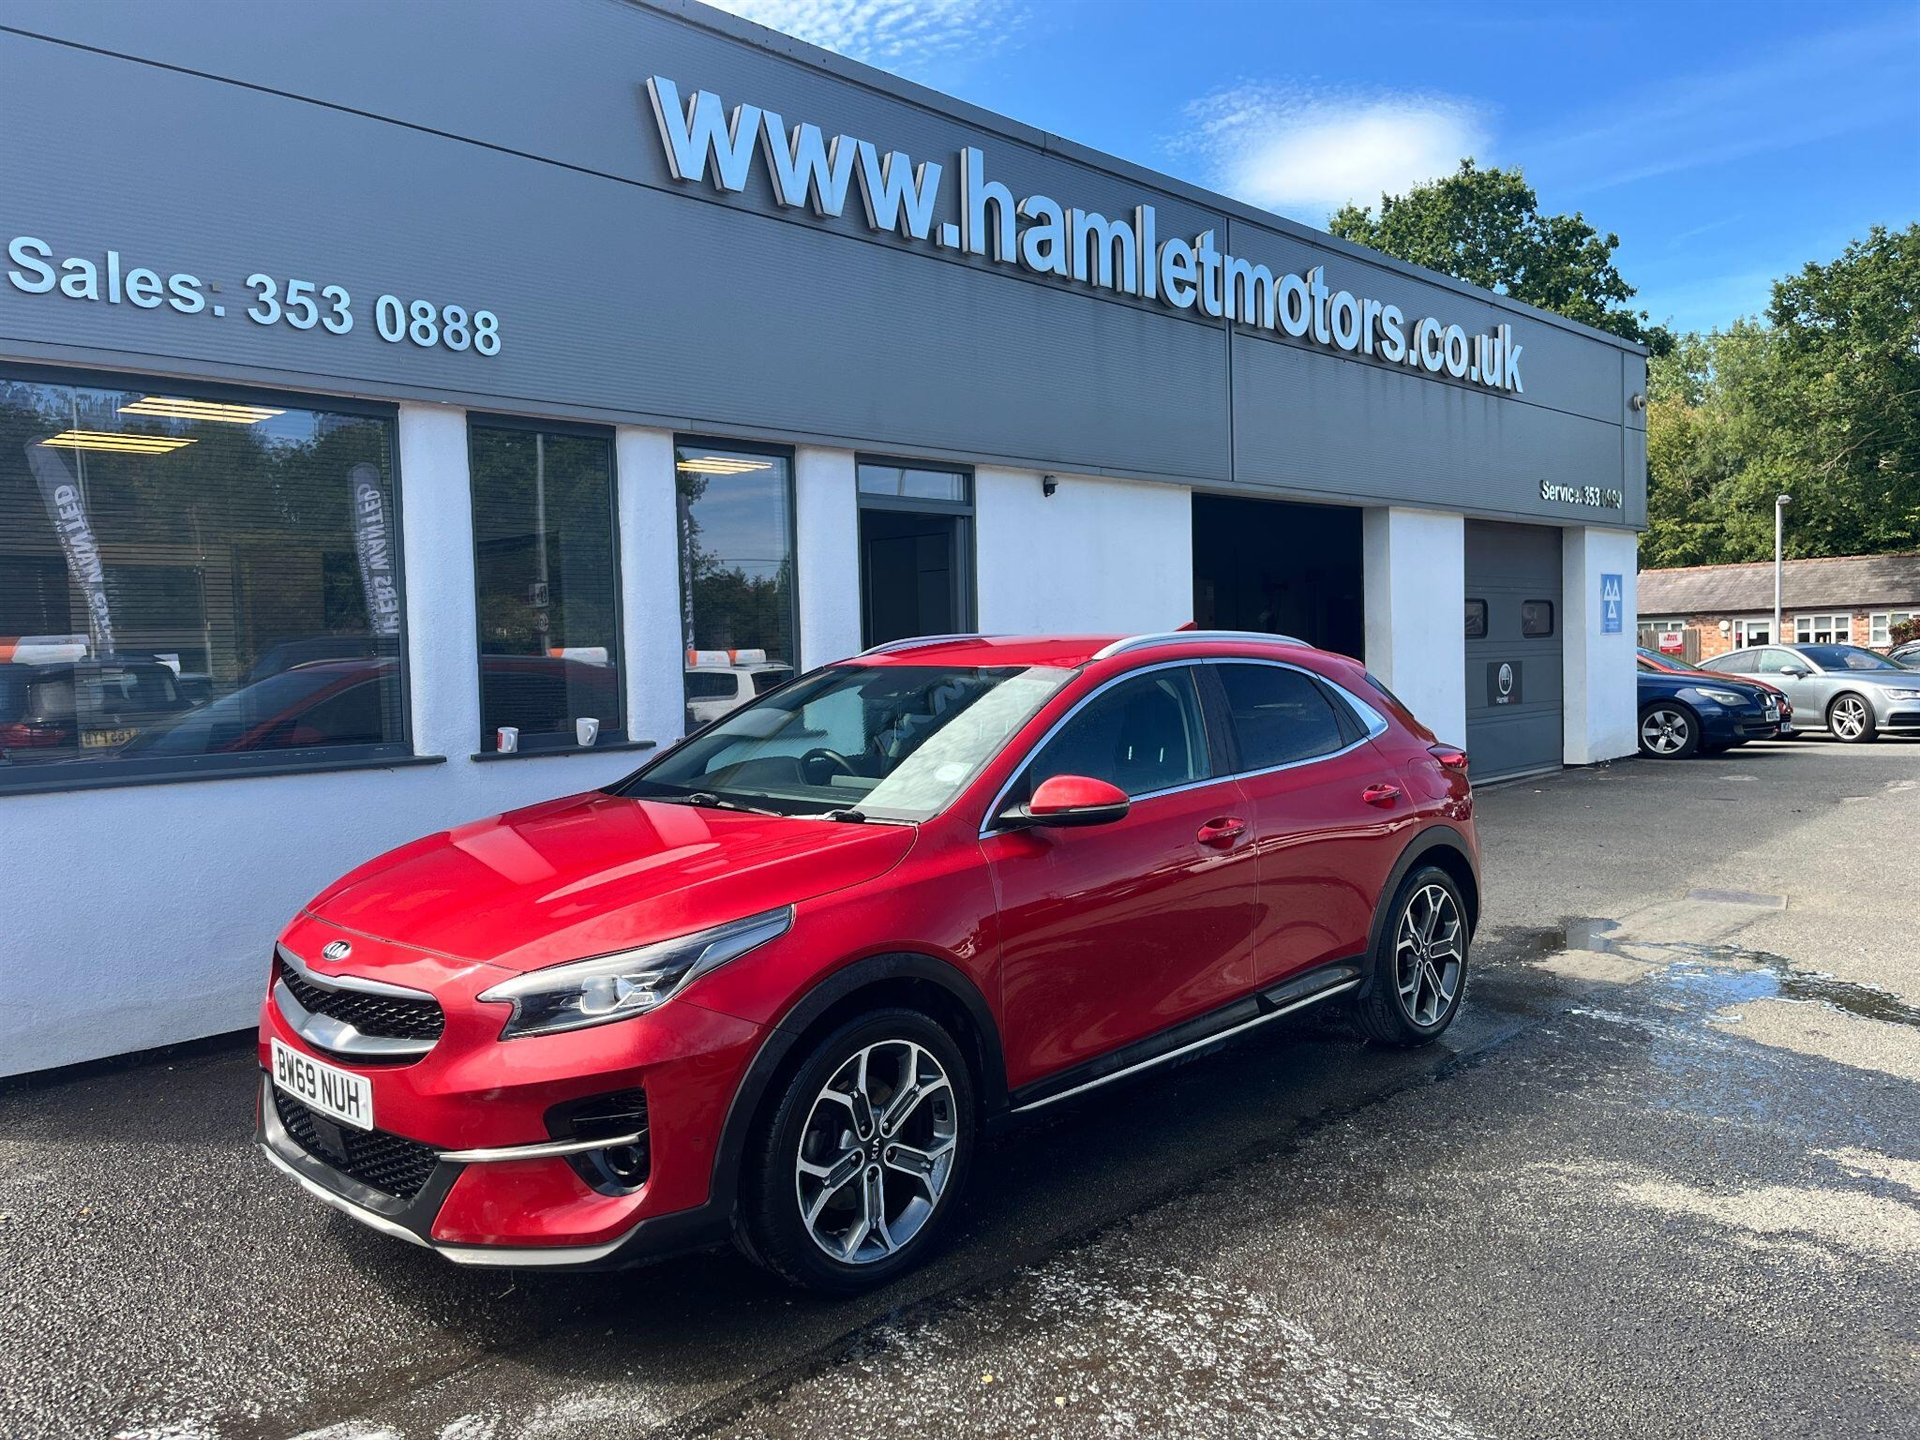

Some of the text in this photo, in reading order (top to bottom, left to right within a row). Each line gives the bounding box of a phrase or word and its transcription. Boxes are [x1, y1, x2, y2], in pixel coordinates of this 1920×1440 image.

[646, 74, 1524, 395] www.hamletmotors.co.uk
[7, 236, 501, 356] Sales: 353 0888
[1584, 486, 1600, 507] 353
[323, 940, 351, 960] KIA
[277, 1046, 360, 1119] BW69 NUH
[871, 1137, 880, 1160] KIA
